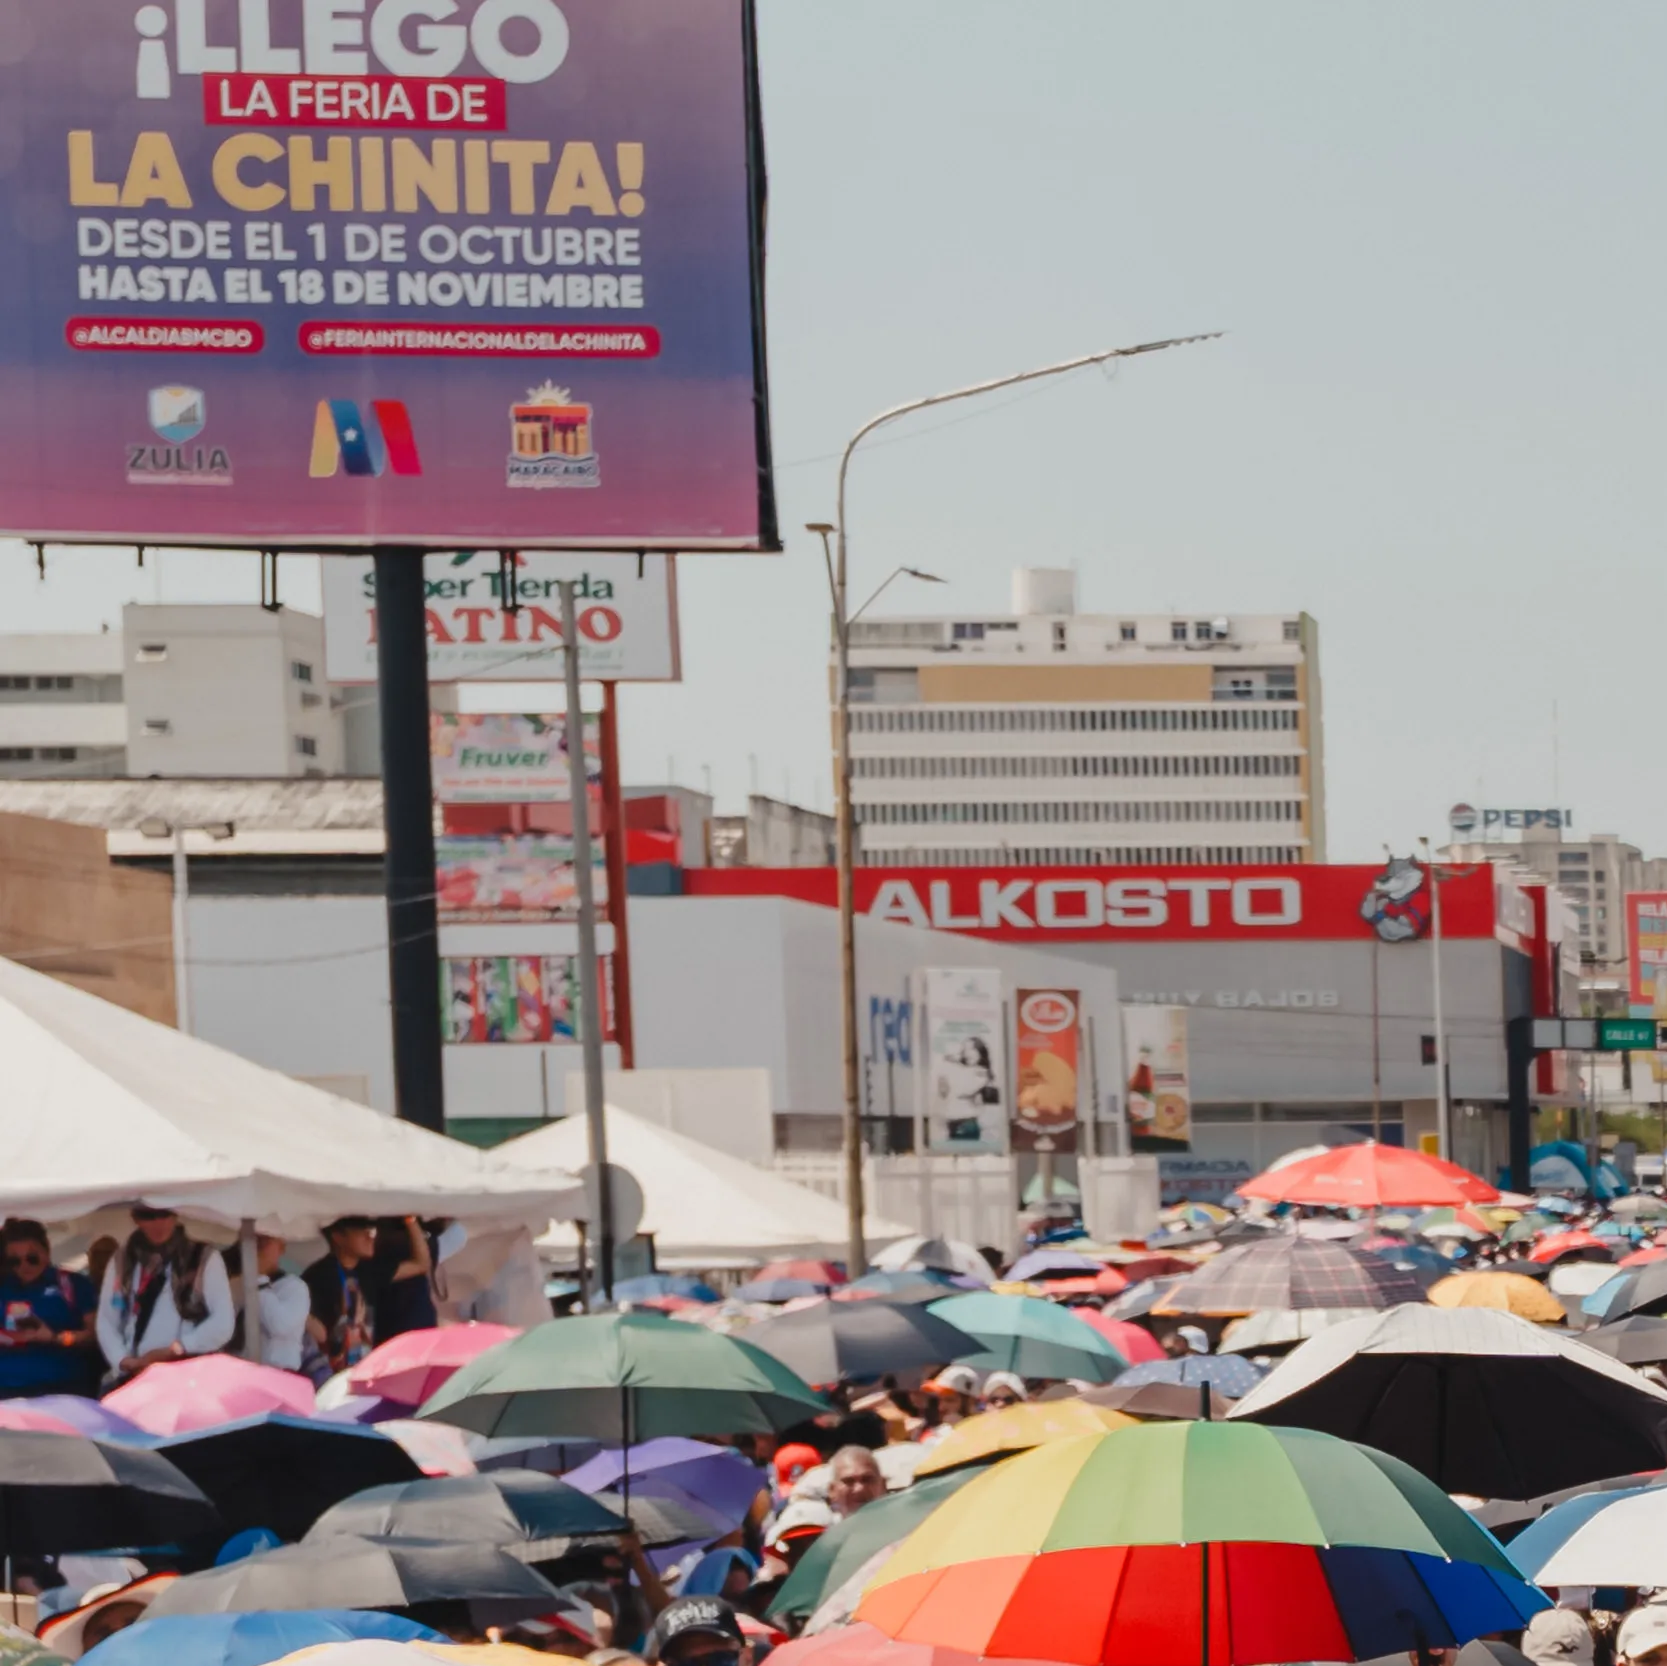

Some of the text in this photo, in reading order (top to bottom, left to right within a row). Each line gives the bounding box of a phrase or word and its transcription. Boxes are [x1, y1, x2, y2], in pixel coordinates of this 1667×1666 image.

[219, 79, 487, 123] LA FERIA DE
[67, 130, 645, 218] LA CHINITA!
[77, 217, 642, 267] DESDE EL 1 DE OCTUBRE
[77, 265, 645, 310] HASTA EL 18 DE NOVIEMBRE
[308, 327, 647, 354] @FERIAINTERNACIONALDELACHINITA
[127, 443, 231, 474] ZULIA
[363, 571, 614, 604] Sper Tenda
[459, 747, 550, 767] Fruver
[1484, 808, 1573, 829] PEPSI
[868, 877, 1302, 929] ALKOSTO
